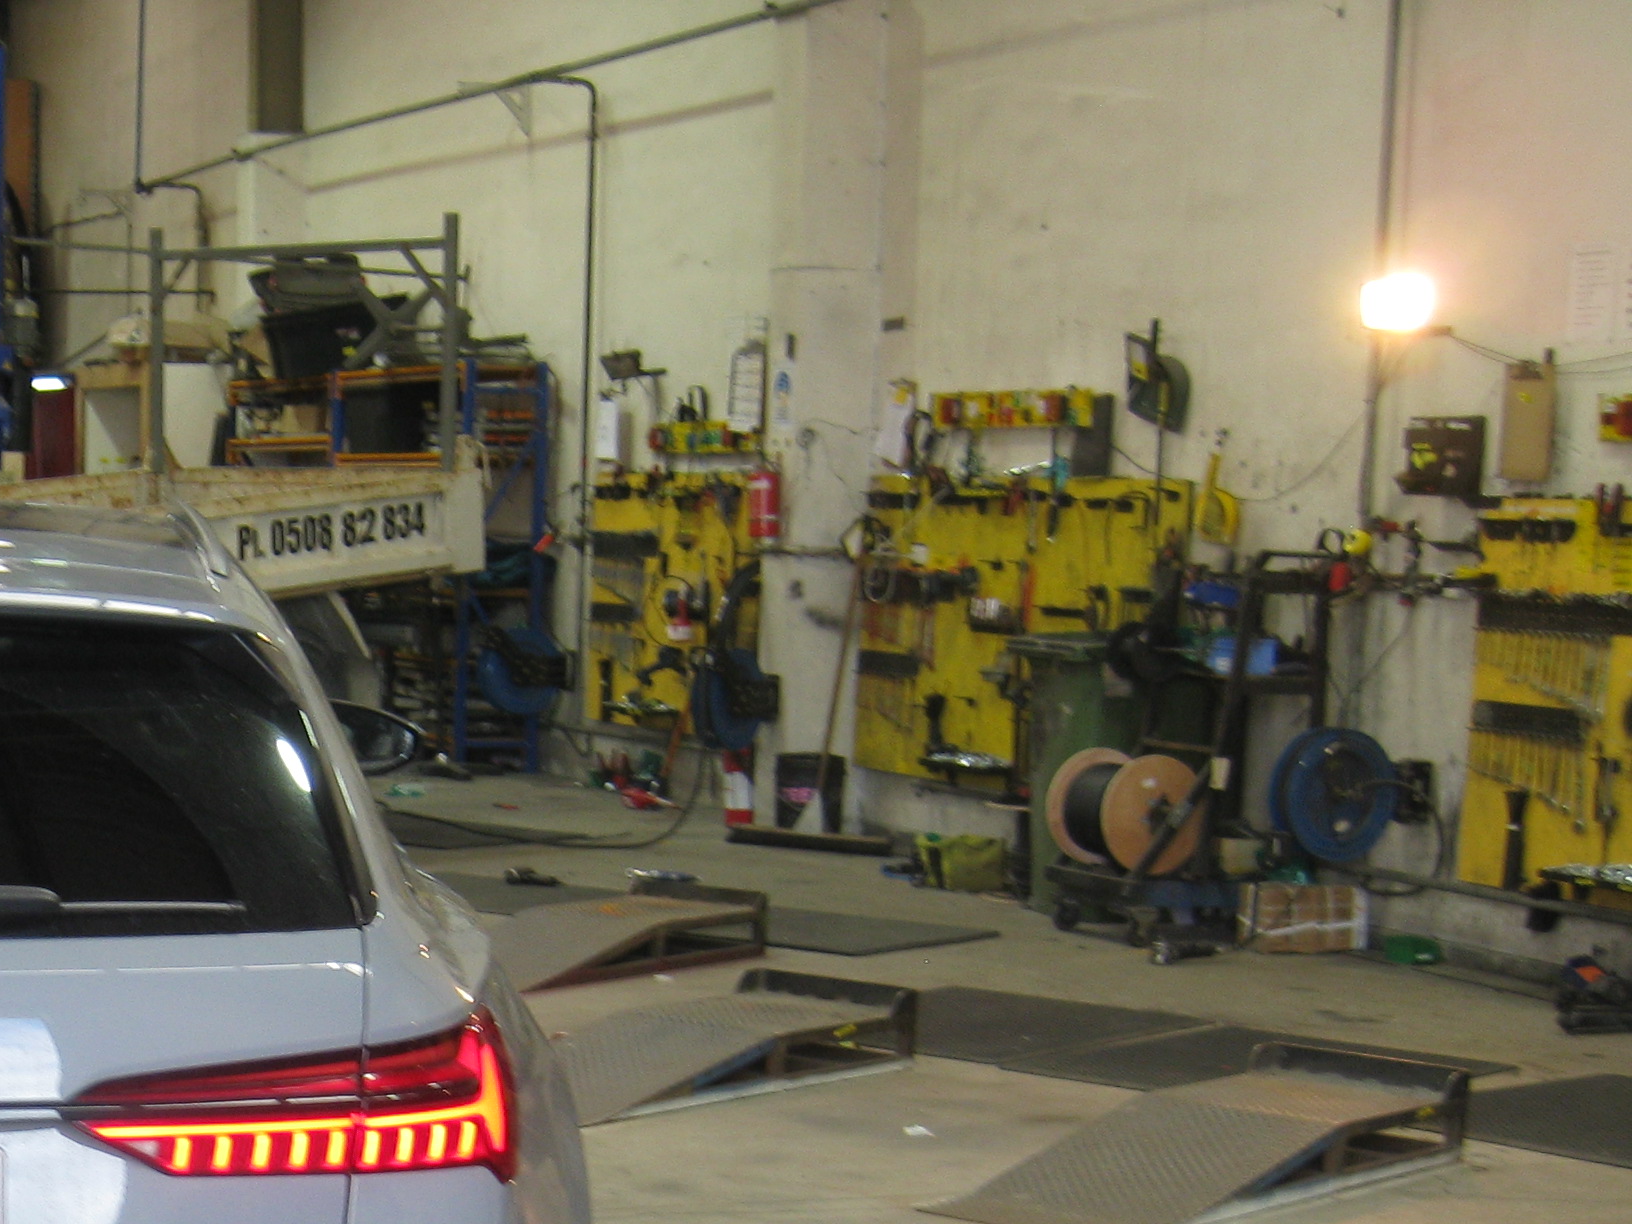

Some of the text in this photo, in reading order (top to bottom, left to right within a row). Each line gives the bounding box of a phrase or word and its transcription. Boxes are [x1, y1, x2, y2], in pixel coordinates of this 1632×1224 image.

[271, 512, 333, 556] 0508
[342, 506, 378, 548] 82
[382, 501, 426, 542] 834
